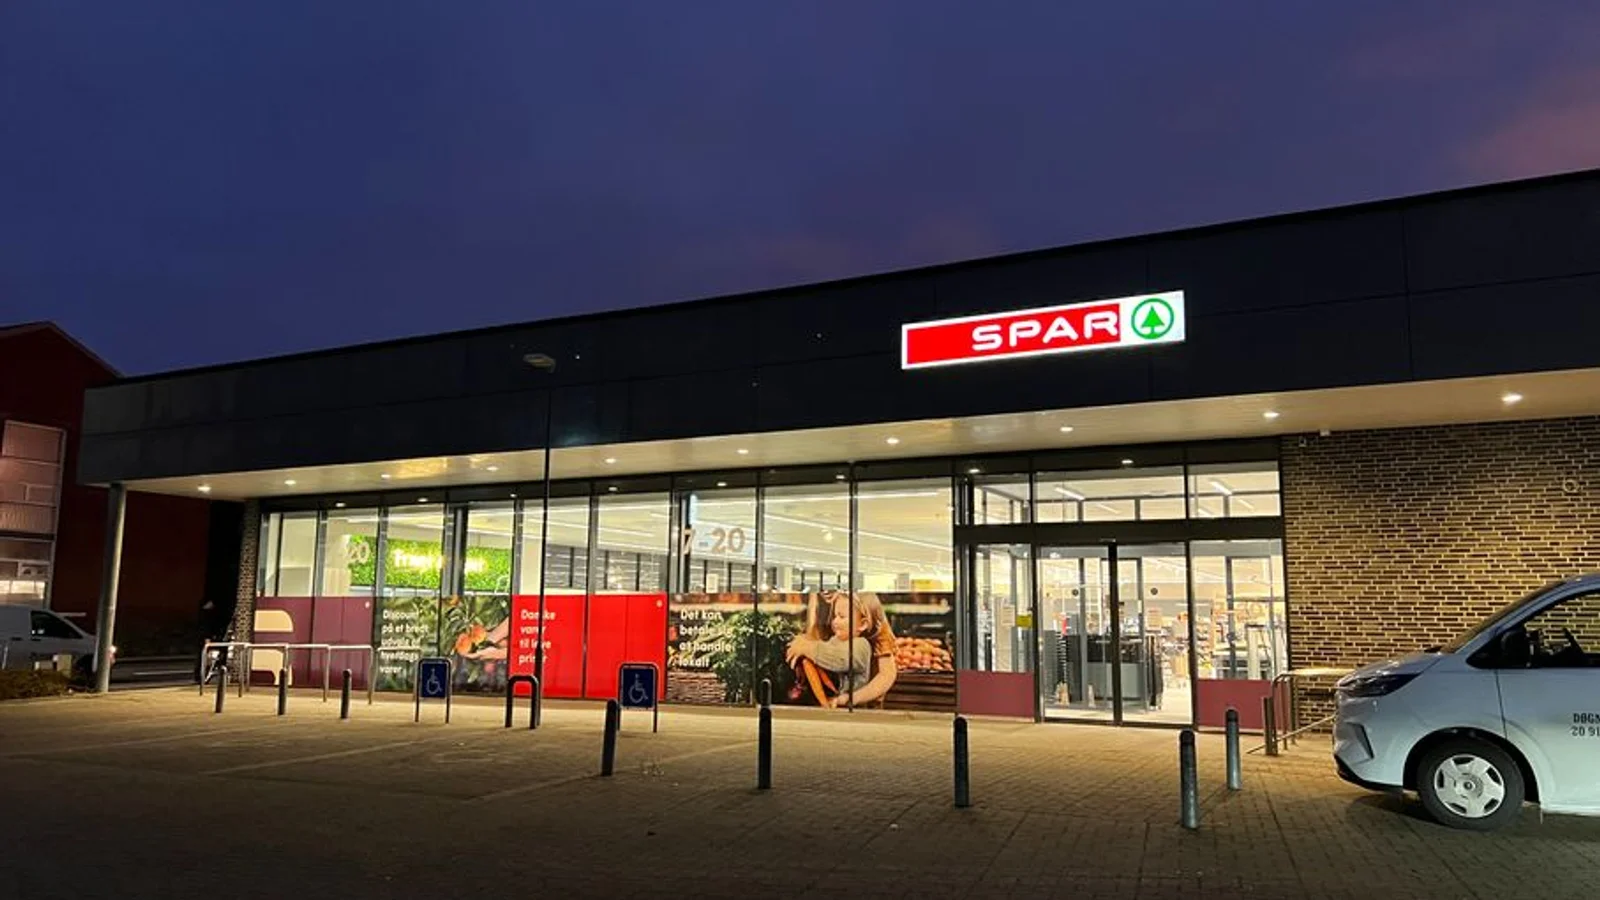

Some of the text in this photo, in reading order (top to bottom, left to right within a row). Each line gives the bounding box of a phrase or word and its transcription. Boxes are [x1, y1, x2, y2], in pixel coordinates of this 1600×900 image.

[971, 310, 1118, 351] SPAR
[383, 609, 418, 620] Discount
[520, 609, 556, 620] Danke
[680, 609, 722, 620] Det kan
[381, 623, 429, 635] på et bredt
[519, 638, 529, 649] til
[679, 656, 709, 668] lokalt
[1571, 725, 1585, 736] 20
